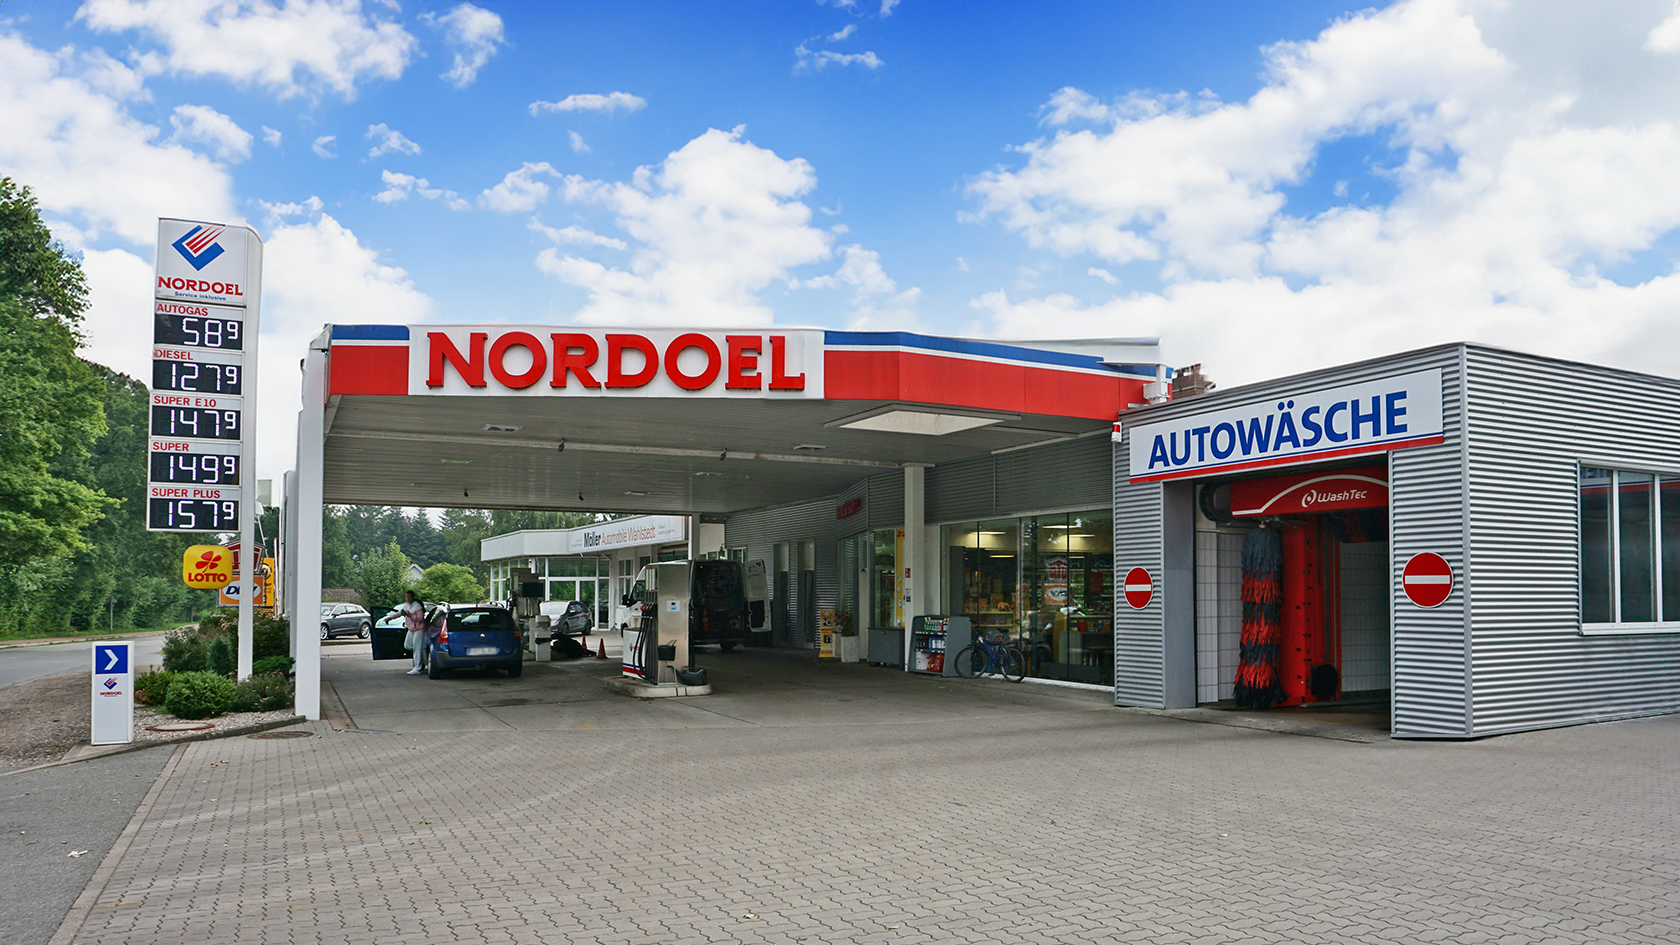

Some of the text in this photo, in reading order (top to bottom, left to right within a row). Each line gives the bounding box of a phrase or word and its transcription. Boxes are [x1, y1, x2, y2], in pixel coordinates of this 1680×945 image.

[157, 276, 244, 296] NORDOEL
[156, 303, 209, 317] AUTOGAS
[154, 349, 194, 360] DIESEL
[426, 331, 806, 391] NORDOEL
[153, 395, 217, 408] SUPER E10
[1148, 390, 1408, 470] AUTOWÄSCHE
[152, 441, 190, 452] SUPER
[151, 487, 221, 499] SUPER PLUS
[1317, 489, 1368, 503] WashTec
[583, 531, 601, 548] Möller
[601, 529, 628, 546] Automobile
[627, 523, 656, 542] Wahlstedt
[188, 572, 228, 583] LOTTO
